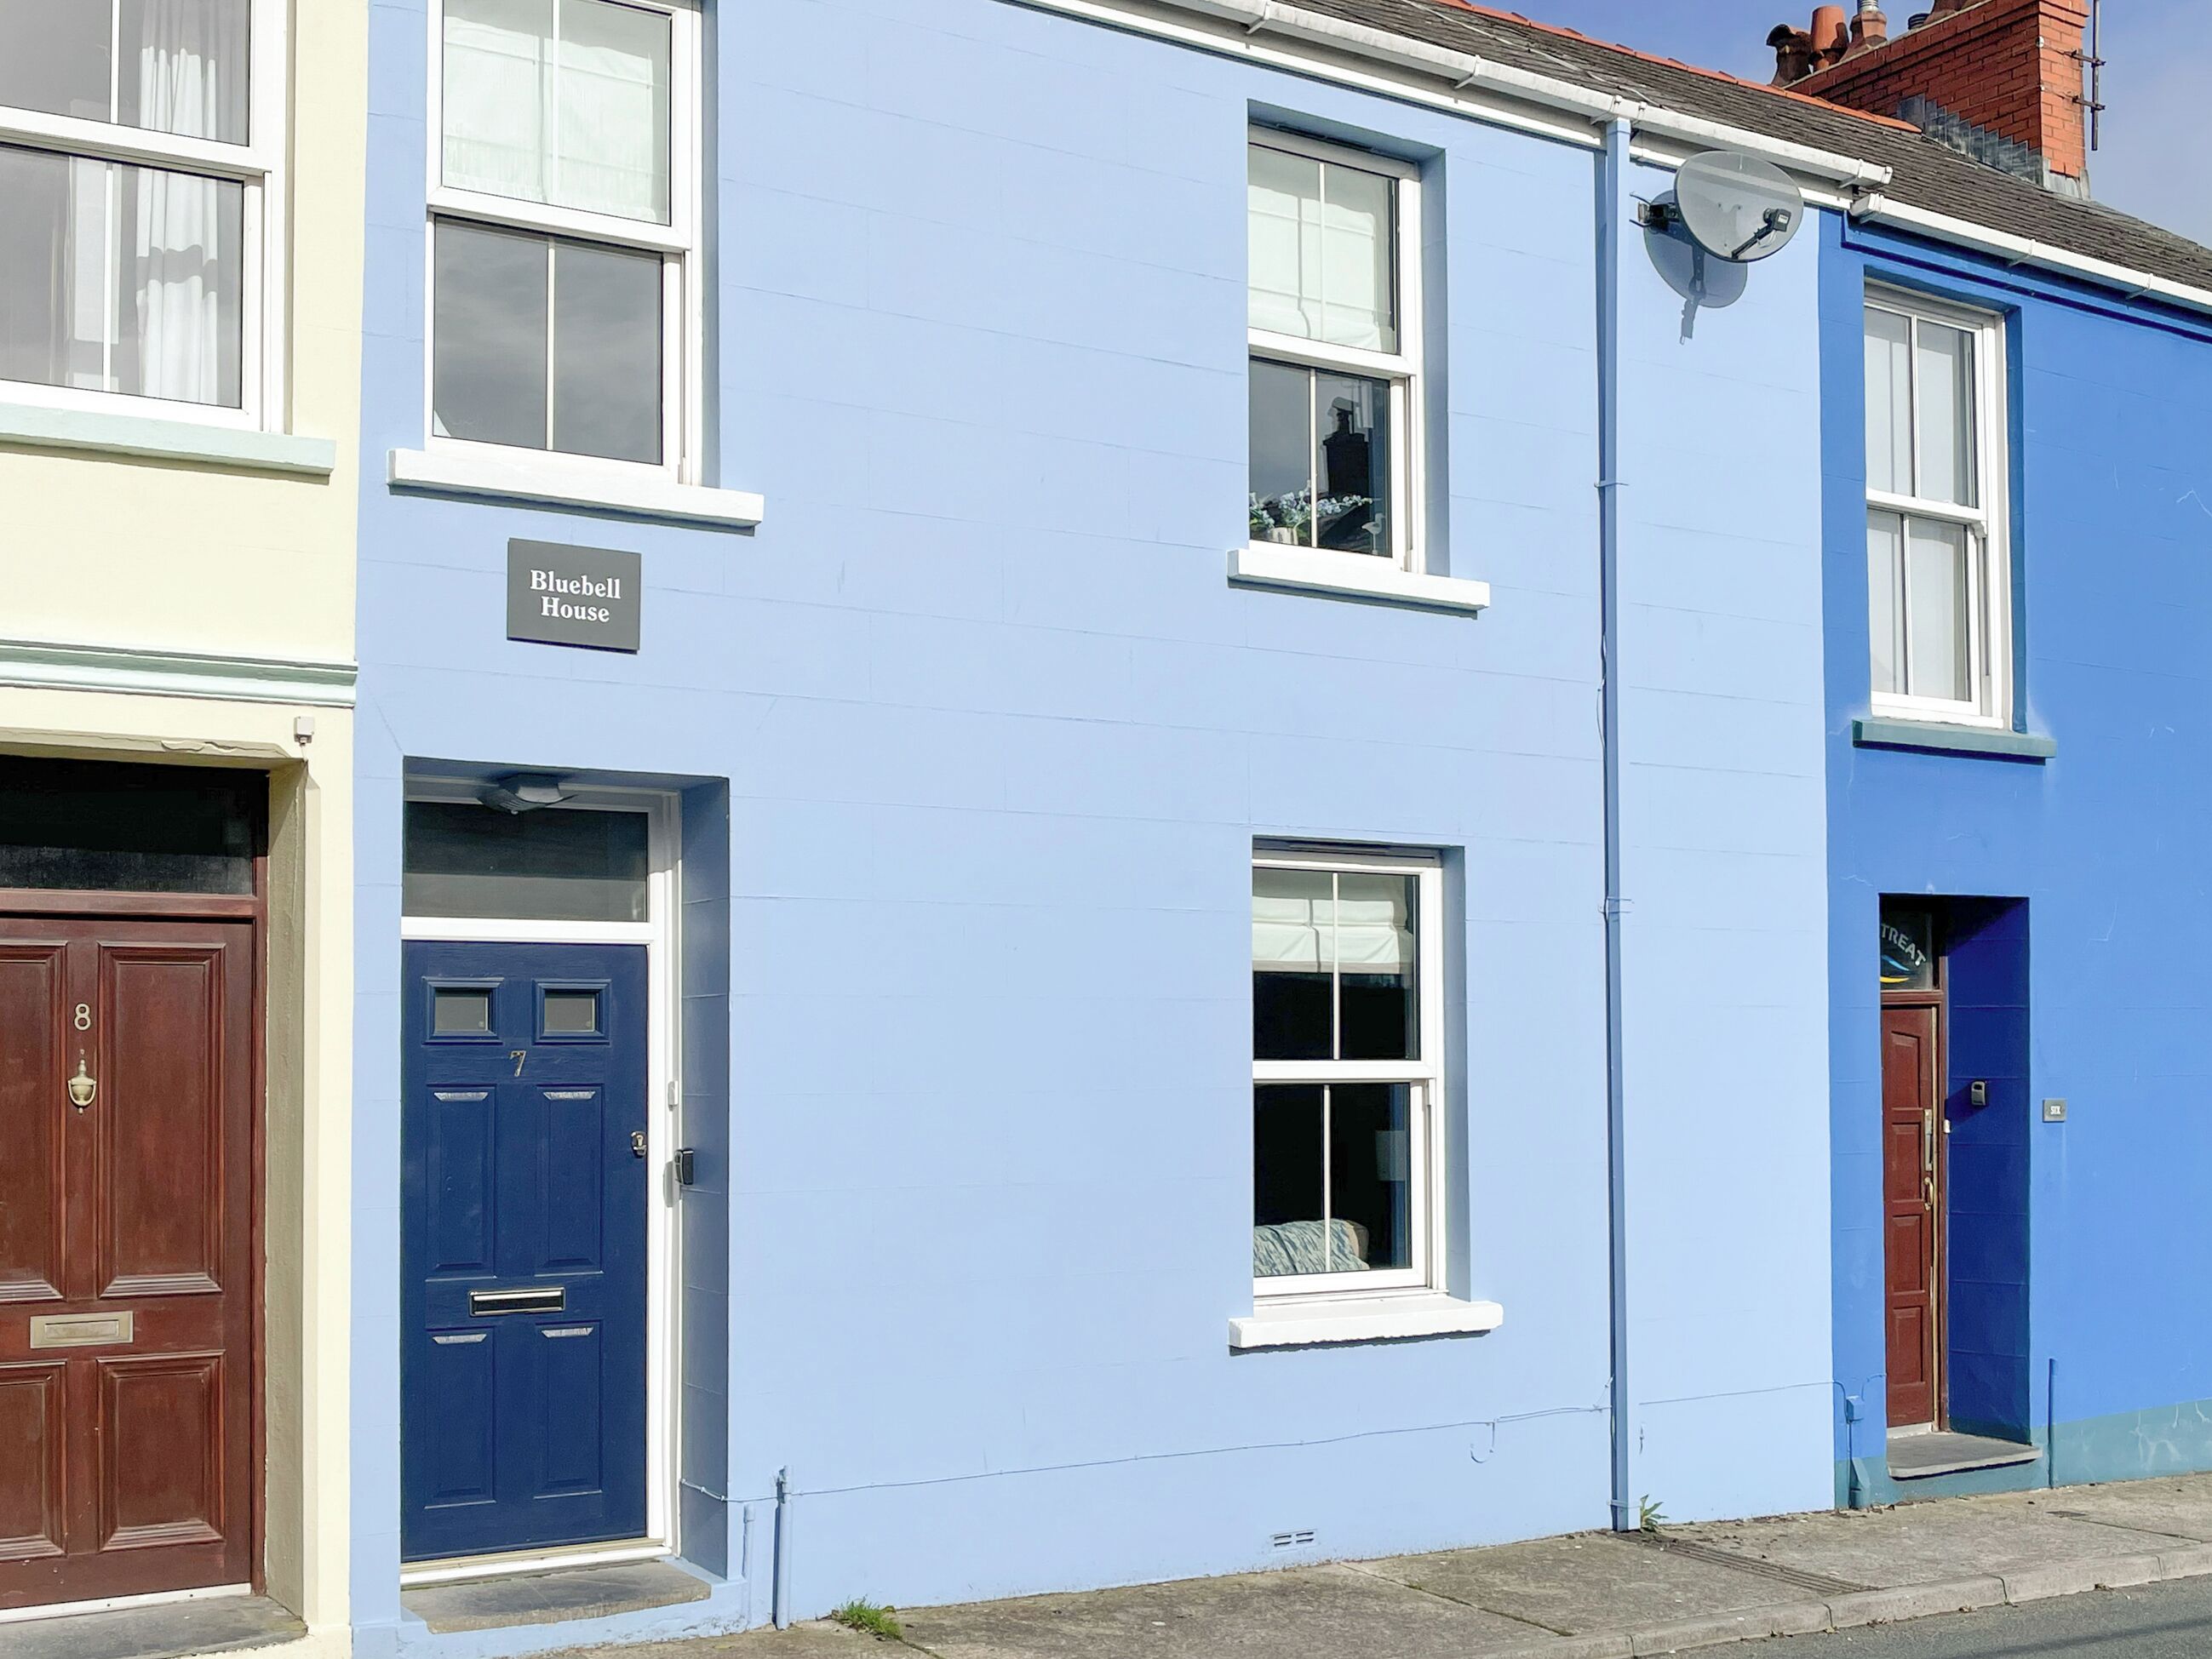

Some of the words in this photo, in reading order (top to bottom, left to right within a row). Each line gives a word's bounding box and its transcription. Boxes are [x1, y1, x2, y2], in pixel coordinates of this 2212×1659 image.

[530, 569, 622, 599] Bluebell
[541, 596, 610, 622] House
[1881, 923, 1927, 966] TREAT
[74, 1003, 91, 1031] 8
[510, 1050, 526, 1077] 7
